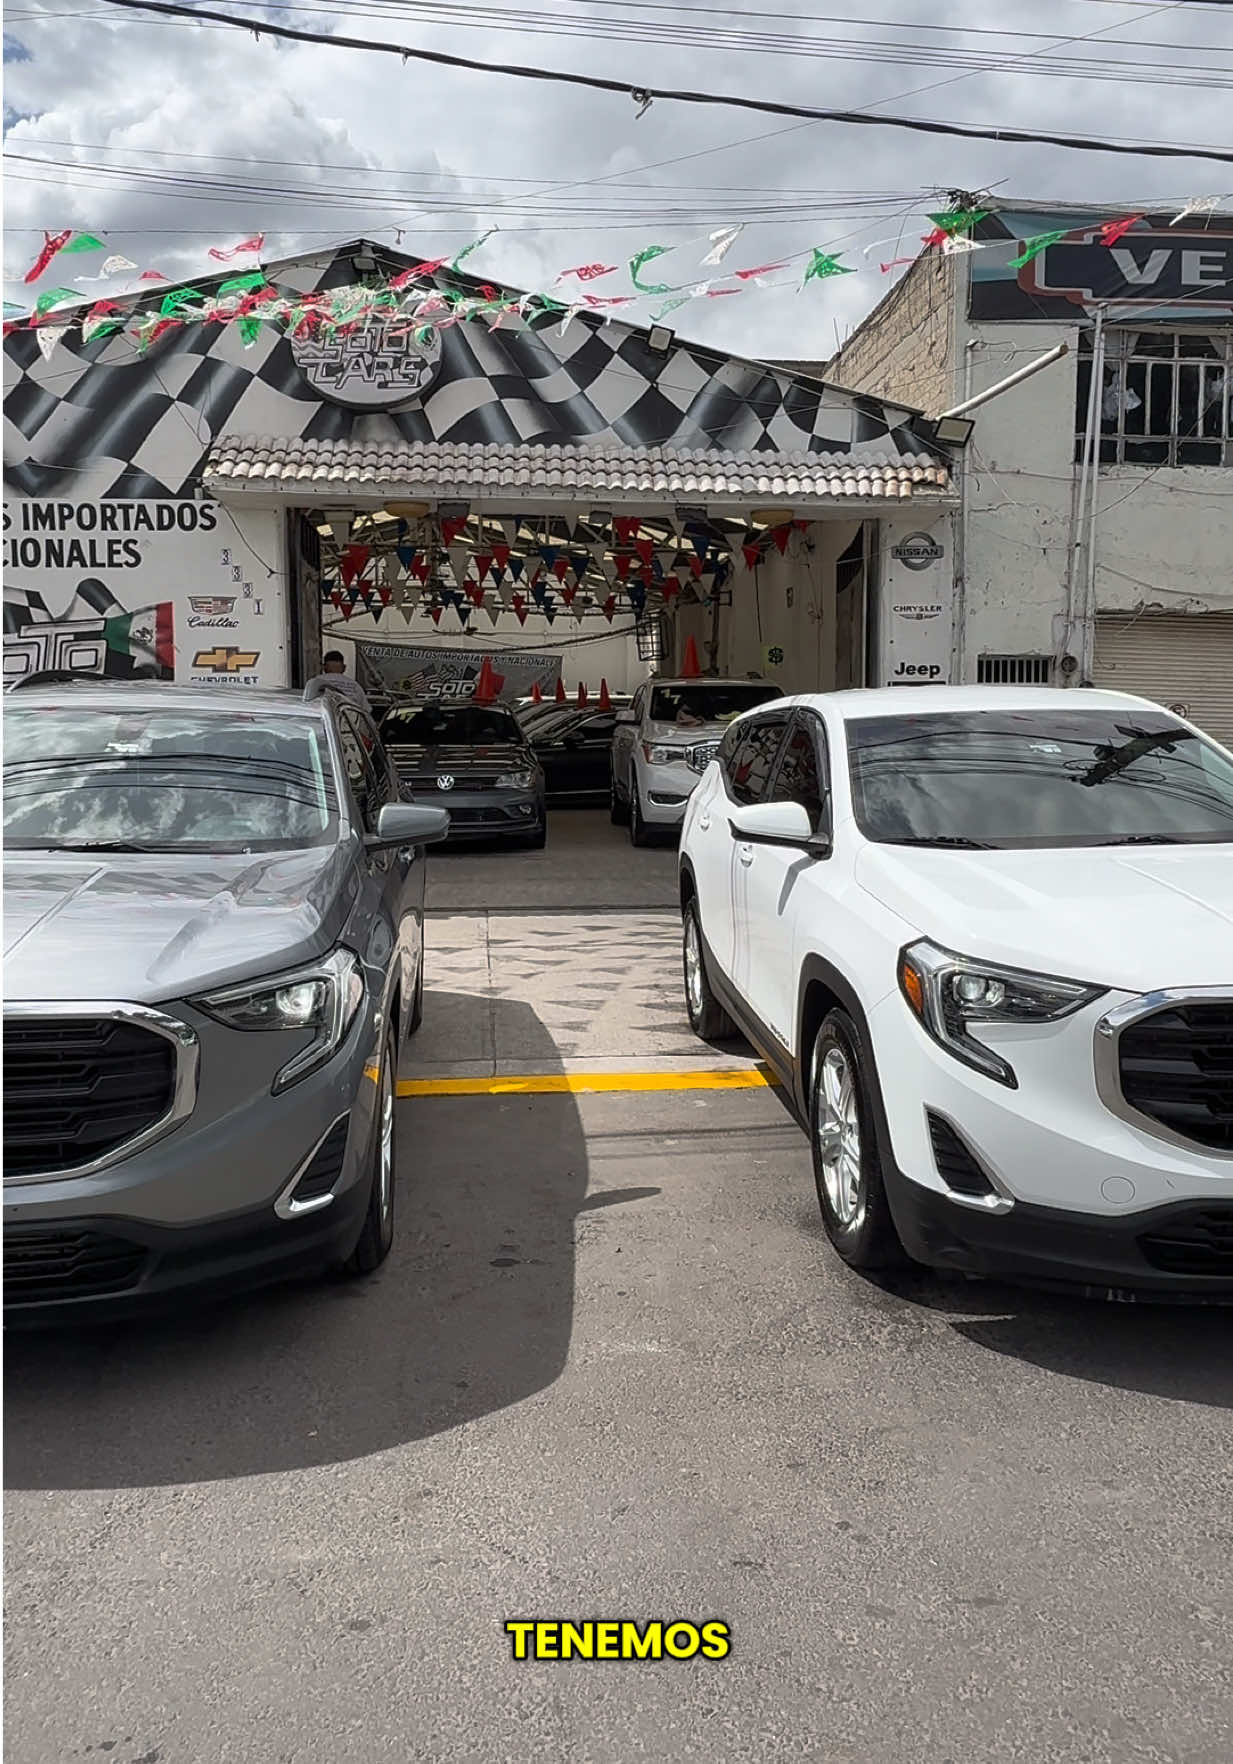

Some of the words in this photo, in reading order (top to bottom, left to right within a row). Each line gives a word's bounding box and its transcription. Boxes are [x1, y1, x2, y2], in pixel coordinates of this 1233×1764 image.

[1109, 249, 1227, 286] VE
[298, 354, 422, 389] CARS
[22, 503, 217, 531] IMPORTADOS
[3, 538, 142, 568] IONALES
[895, 547, 939, 556] NISSAN
[893, 605, 943, 613] CHRYSLER
[187, 616, 239, 629] Cadillac
[408, 649, 437, 660] AUTOS
[894, 662, 941, 679] Jeep
[424, 679, 476, 697] SOTO
